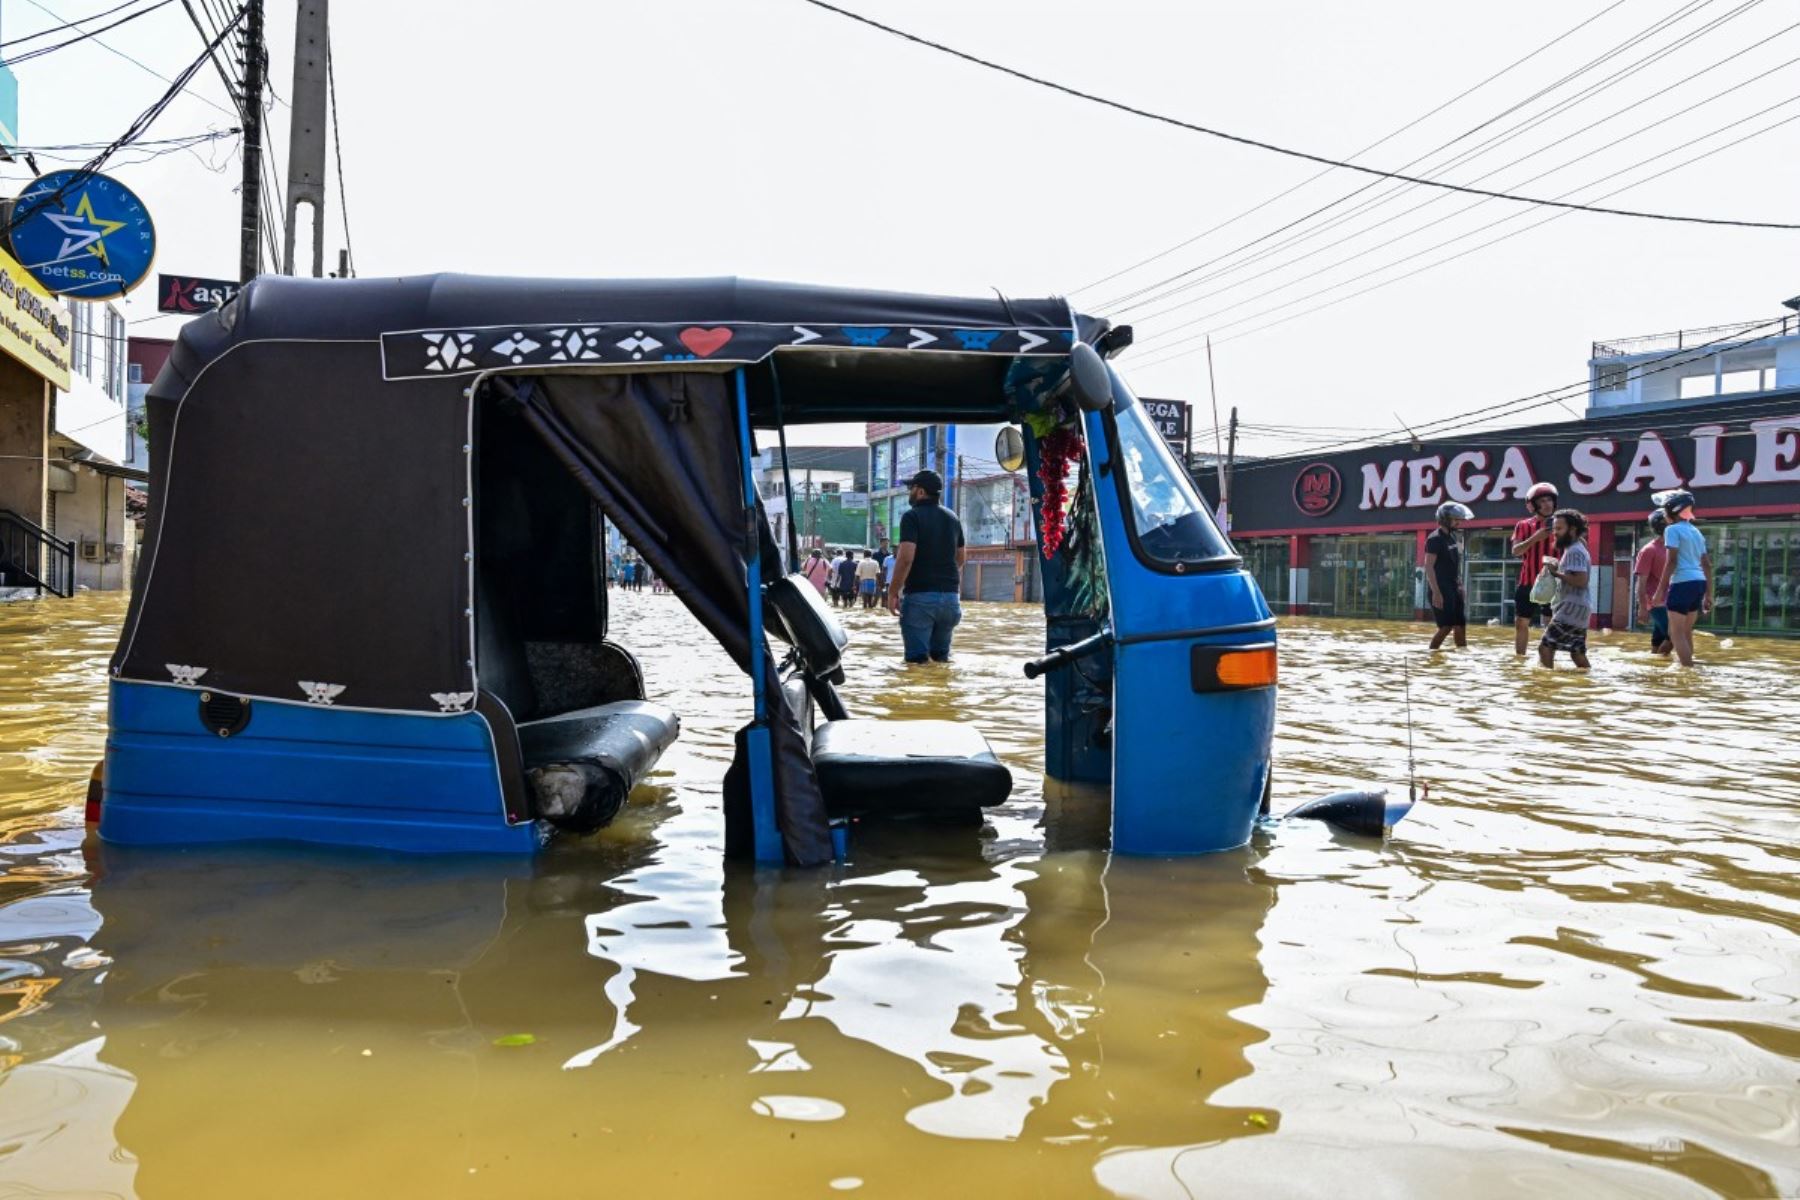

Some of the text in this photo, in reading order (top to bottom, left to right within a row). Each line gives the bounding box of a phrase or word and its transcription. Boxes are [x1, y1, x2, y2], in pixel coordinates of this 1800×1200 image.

[119, 193, 150, 239] STAR
[42, 265, 122, 281] betss.com
[1143, 403, 1180, 418] EGA
[1156, 421, 1177, 436] LE
[1358, 416, 1800, 510] MEGA SALE
